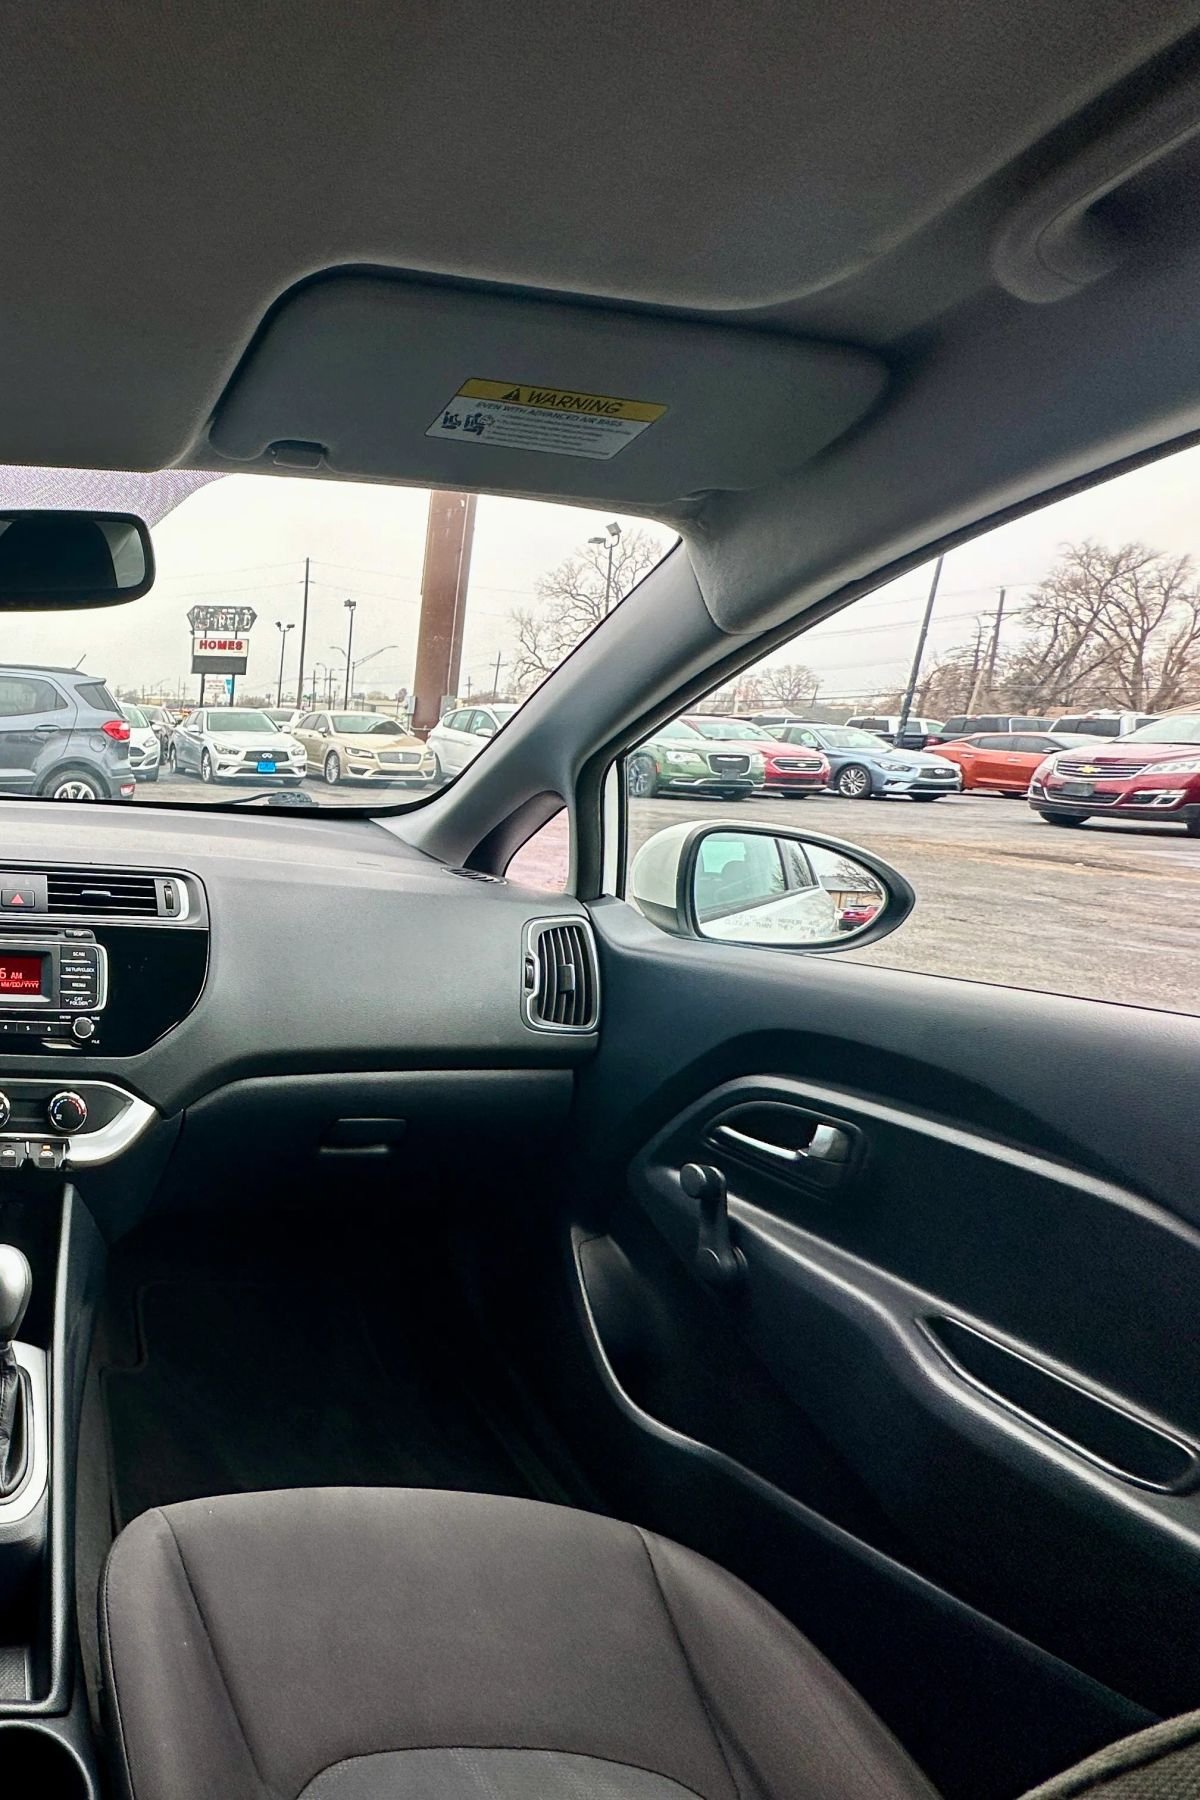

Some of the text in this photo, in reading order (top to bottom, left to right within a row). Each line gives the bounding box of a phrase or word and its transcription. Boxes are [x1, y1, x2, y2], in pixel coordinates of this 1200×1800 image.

[475, 402, 501, 410] EVEN
[501, 404, 528, 413] WITH
[528, 408, 582, 420] ADVANCED
[528, 390, 623, 414] WARNING
[199, 639, 243, 651] HOMES
